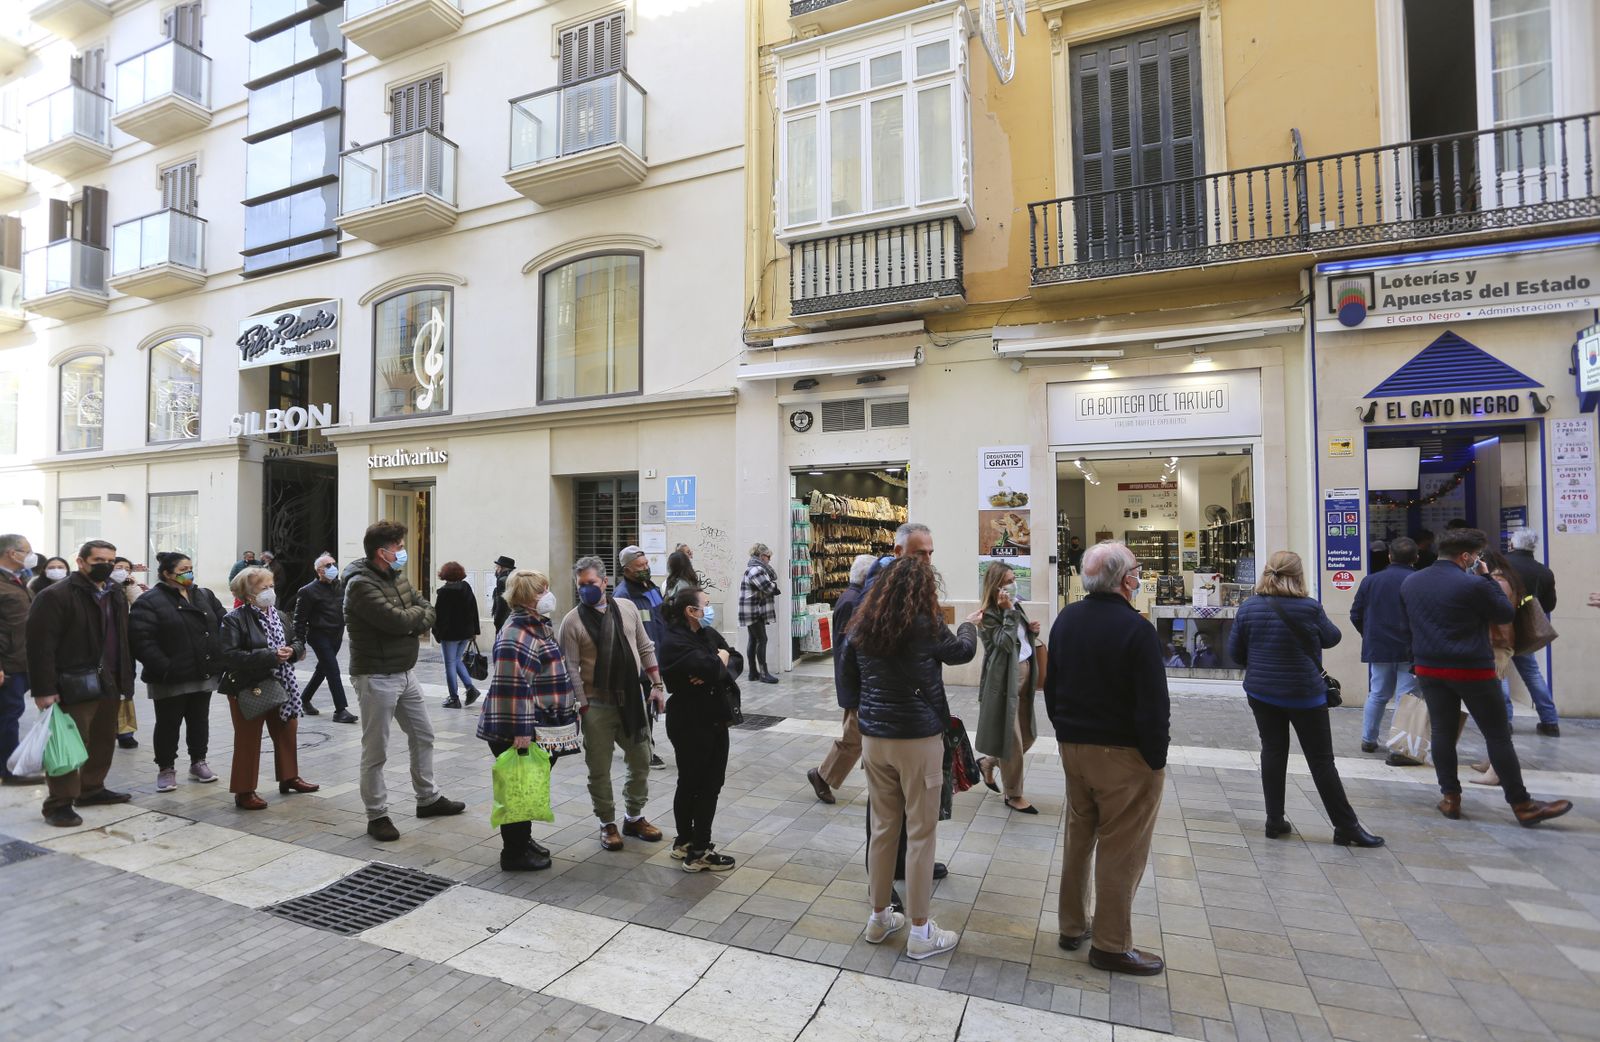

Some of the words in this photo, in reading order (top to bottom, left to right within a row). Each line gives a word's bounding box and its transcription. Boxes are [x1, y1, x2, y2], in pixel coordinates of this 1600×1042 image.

[1380, 270, 1460, 290] Loterías
[1465, 270, 1477, 284] y
[1382, 287, 1473, 310] Apuestas
[1479, 282, 1510, 299] del
[1516, 275, 1590, 295] Estado
[1386, 316, 1395, 324] El
[1398, 314, 1423, 324] Gato
[1428, 310, 1460, 321] Negro
[1584, 298, 1590, 306] 5
[1081, 398, 1094, 416] LA
[1098, 394, 1145, 416] BOTTEGA
[1149, 392, 1170, 413] DEL
[1173, 389, 1224, 411] TARTUFO
[1386, 402, 1406, 419] EL
[1411, 399, 1455, 418] GATO
[1460, 395, 1519, 415] NEGRO
[228, 402, 332, 438] SILBON
[367, 447, 448, 469] stradivarius
[988, 458, 1019, 467] GRATIS
[671, 479, 692, 496] AT
